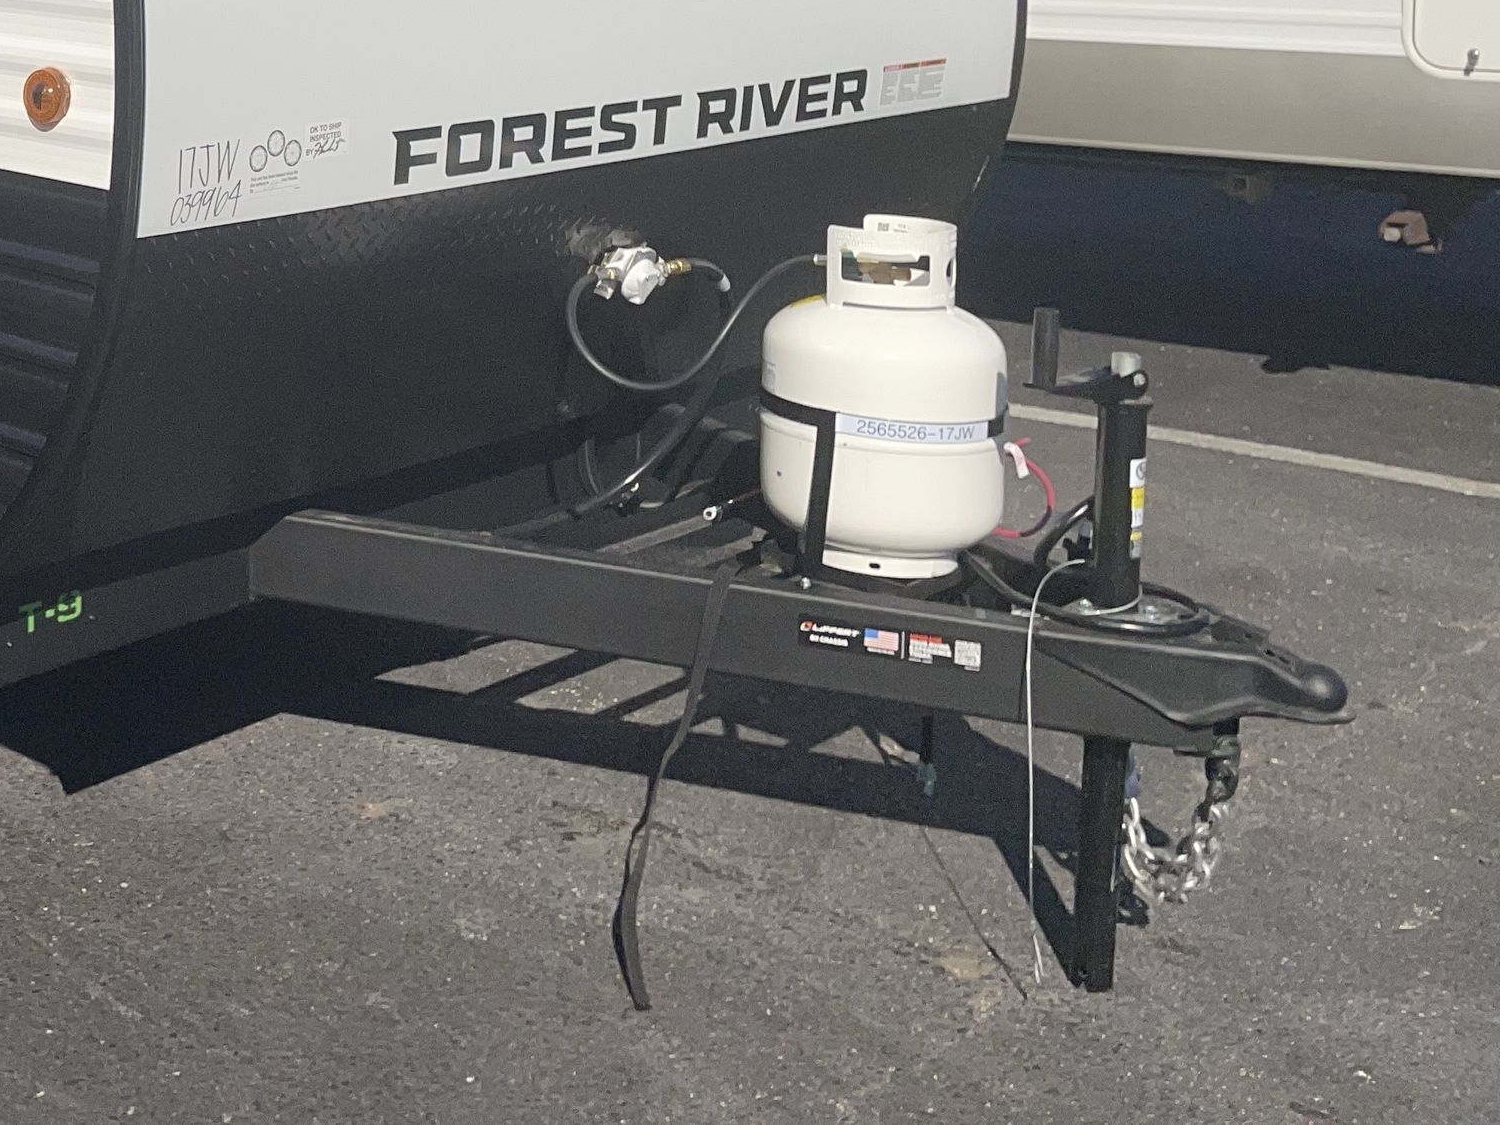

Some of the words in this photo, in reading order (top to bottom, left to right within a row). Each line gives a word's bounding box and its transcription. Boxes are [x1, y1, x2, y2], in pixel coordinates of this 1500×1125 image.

[309, 125, 319, 134] OK
[320, 123, 328, 132] TO
[329, 121, 342, 131] SHIP
[391, 94, 683, 186] FOREST
[696, 68, 868, 139] RIVER
[309, 131, 342, 143] INSPECTED
[856, 419, 976, 441] 2565526-17JW
